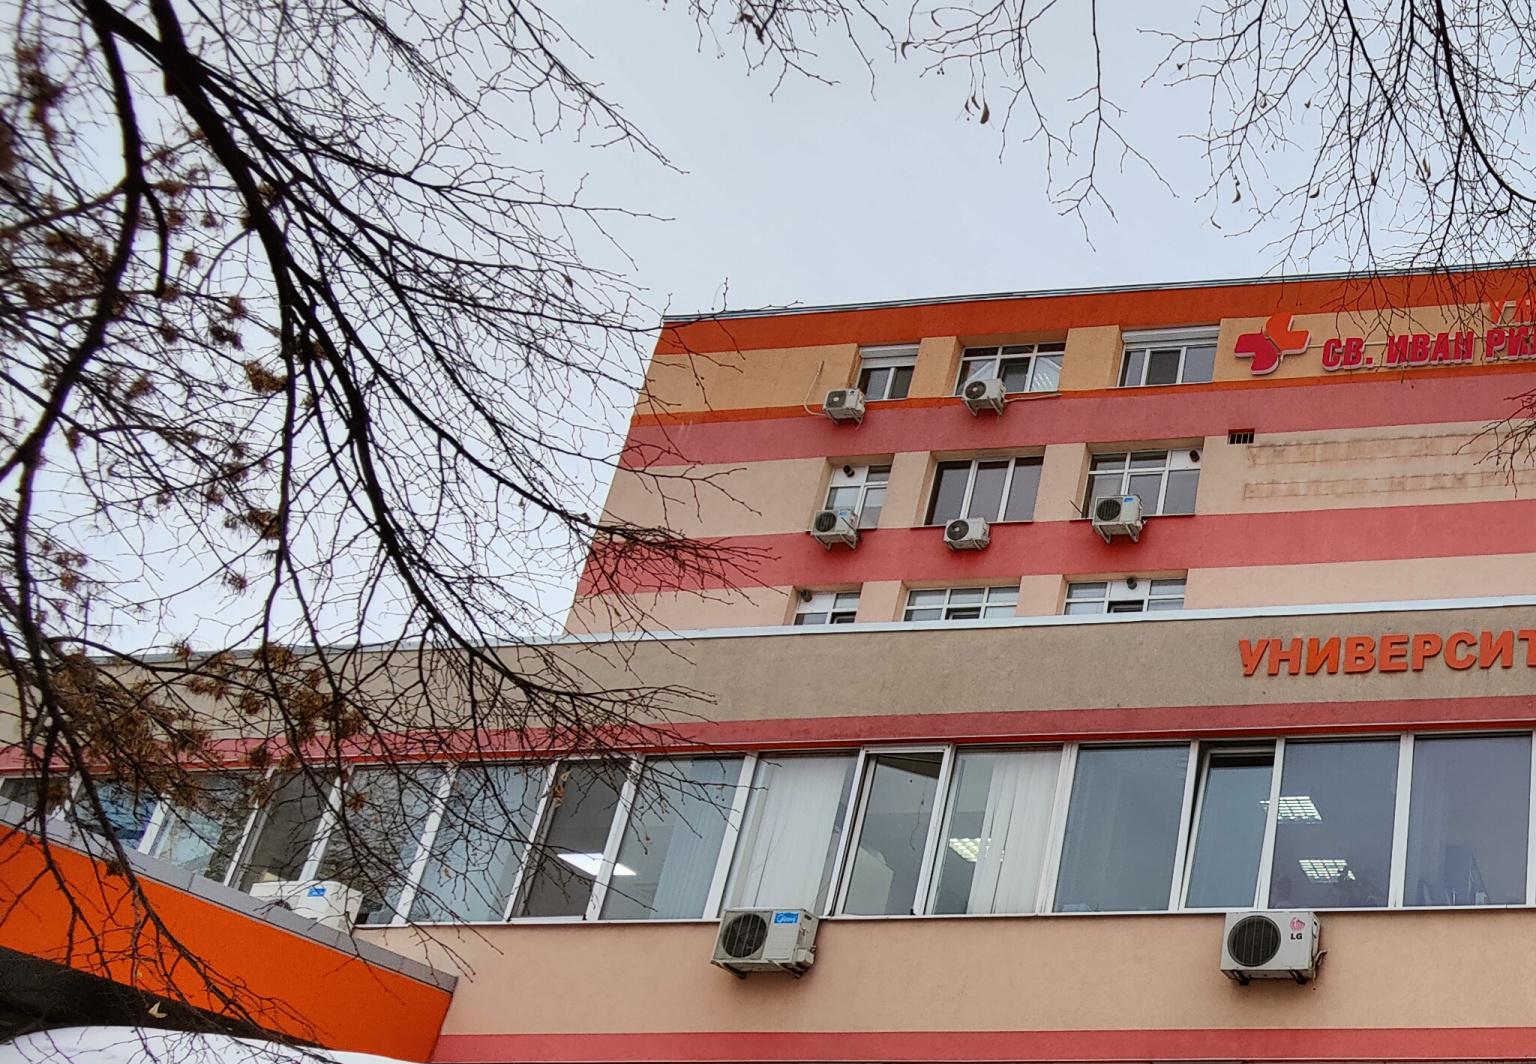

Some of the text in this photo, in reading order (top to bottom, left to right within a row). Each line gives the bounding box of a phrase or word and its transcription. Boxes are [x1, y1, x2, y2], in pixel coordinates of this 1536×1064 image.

[1322, 337, 1374, 372] СВ.
[1386, 330, 1474, 368] ИВАН
[1290, 932, 1303, 940] LG
